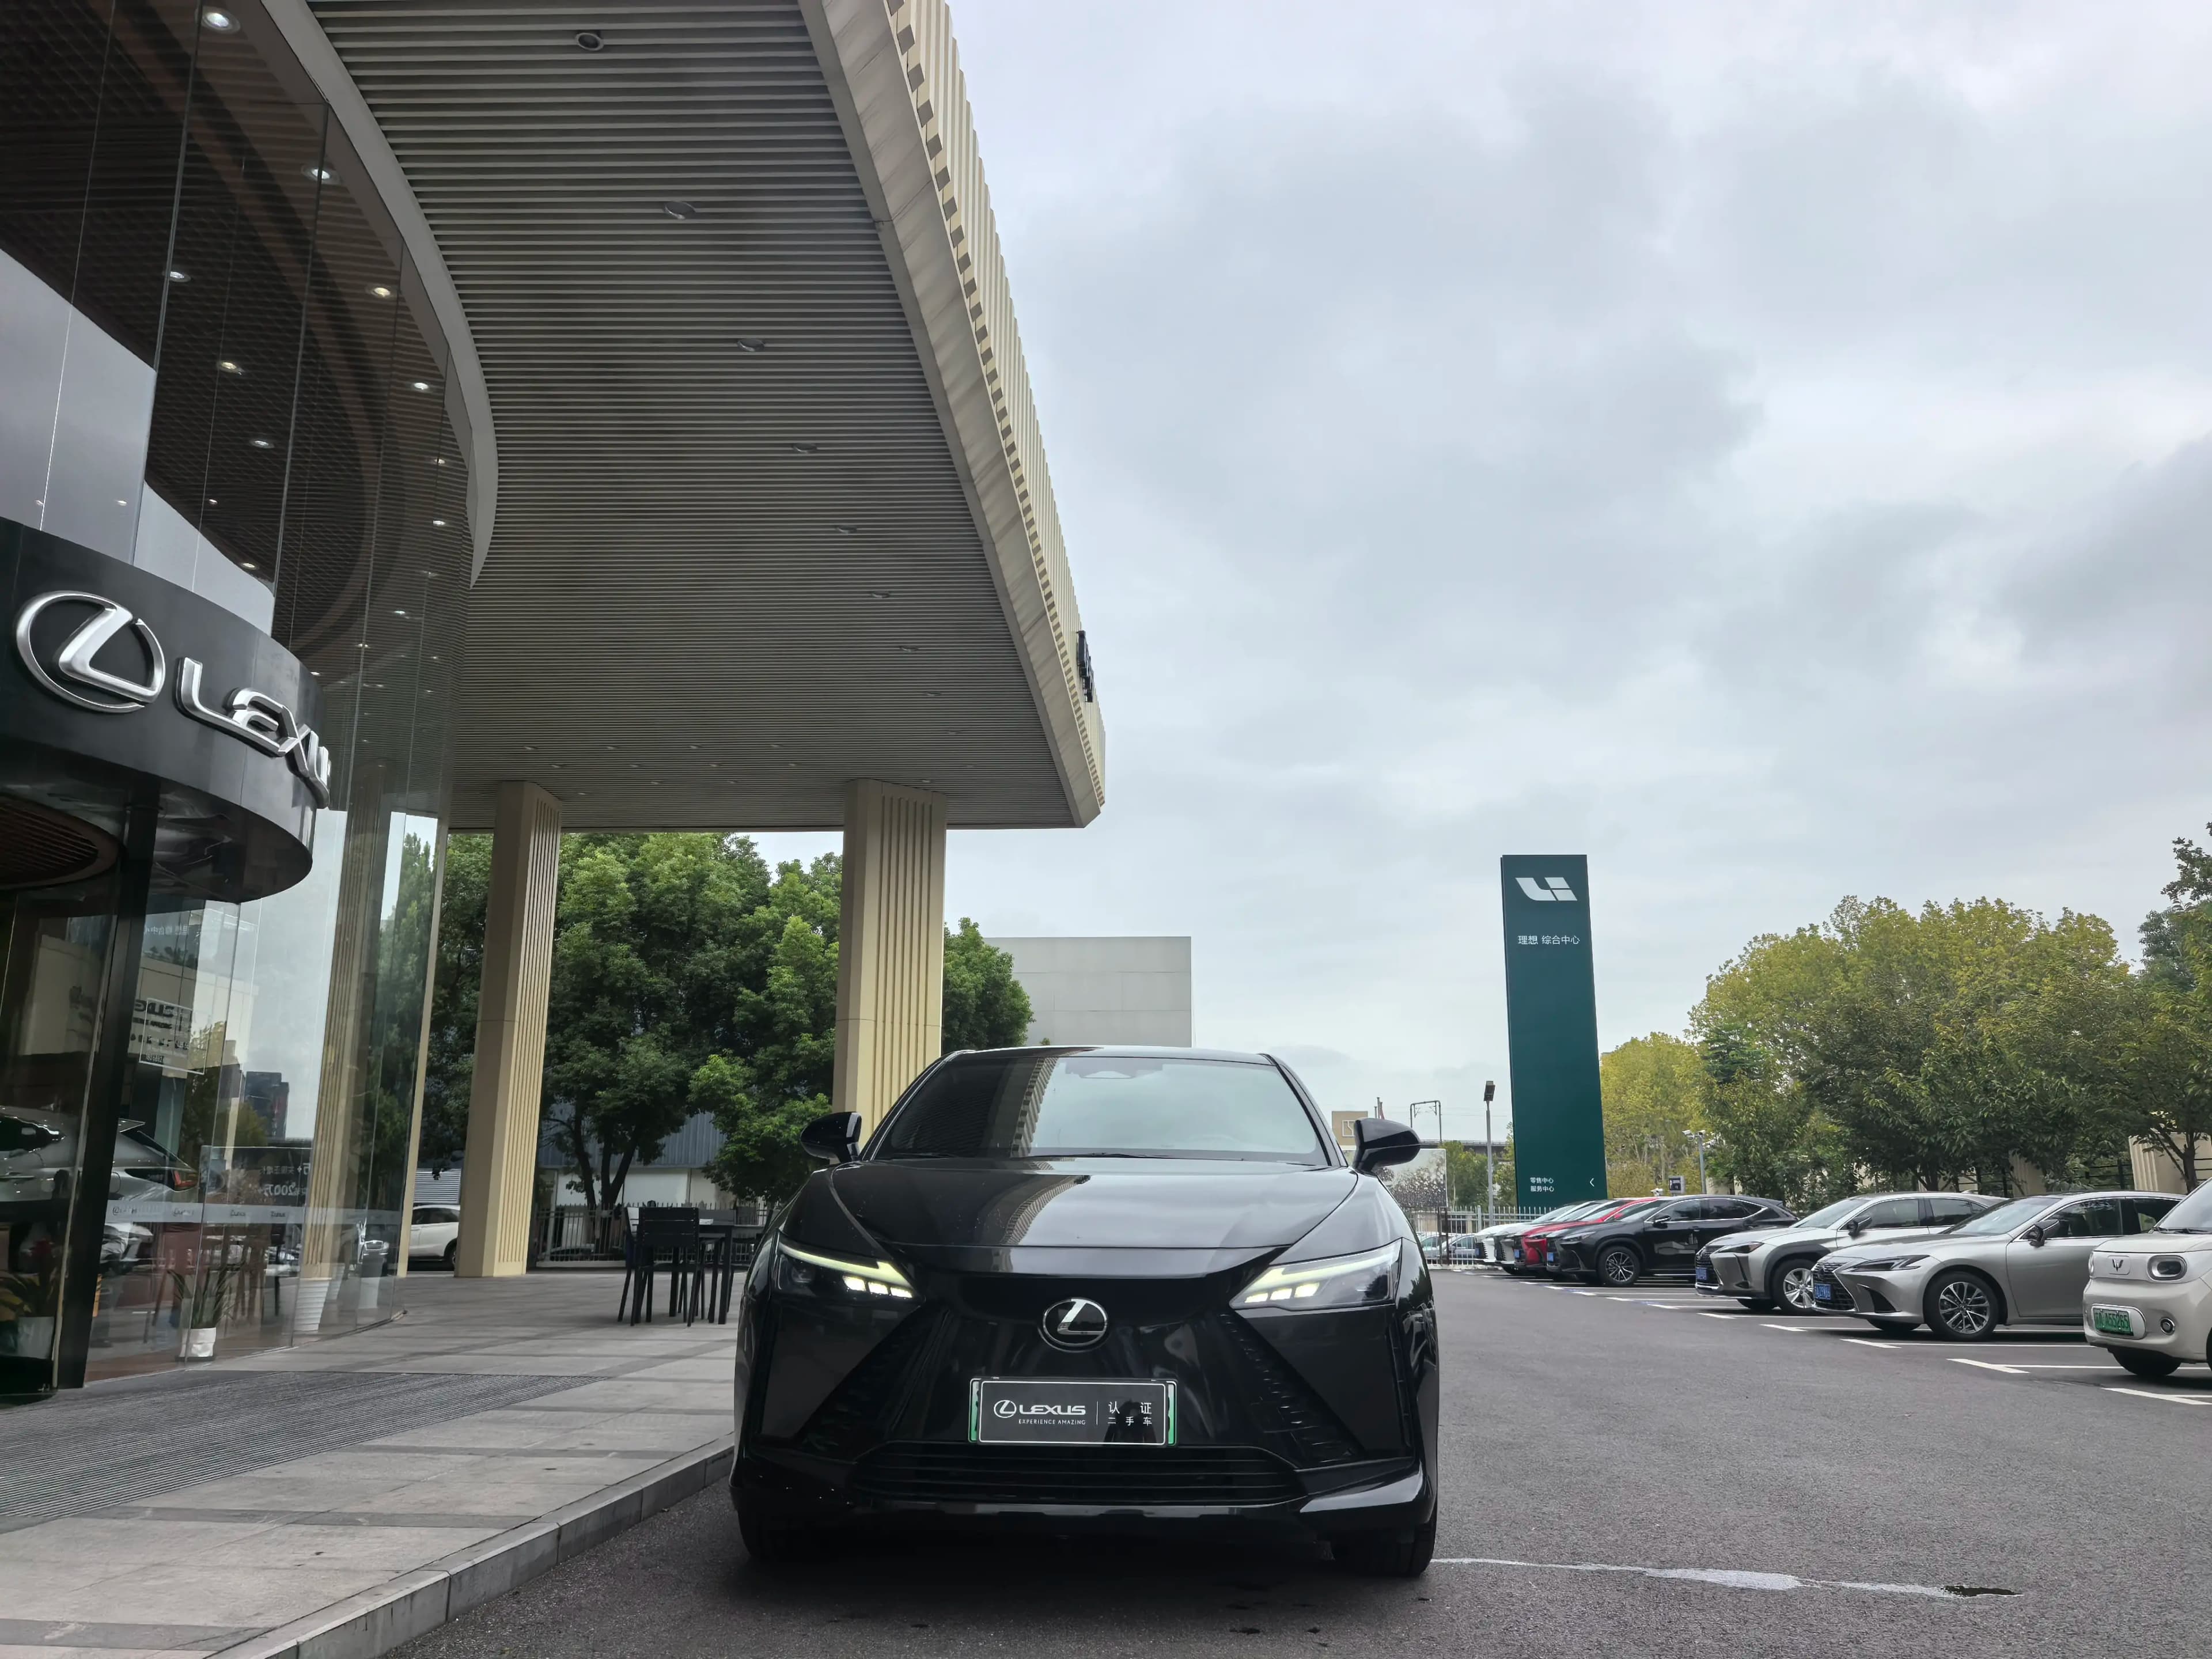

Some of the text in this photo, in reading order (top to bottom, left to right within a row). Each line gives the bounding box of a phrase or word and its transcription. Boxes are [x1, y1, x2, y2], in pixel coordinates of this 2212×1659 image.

[176, 657, 331, 809] LEXU
[1517, 935, 1580, 945] 理想 综合中心
[1019, 1404, 1086, 1415] LEXUS
